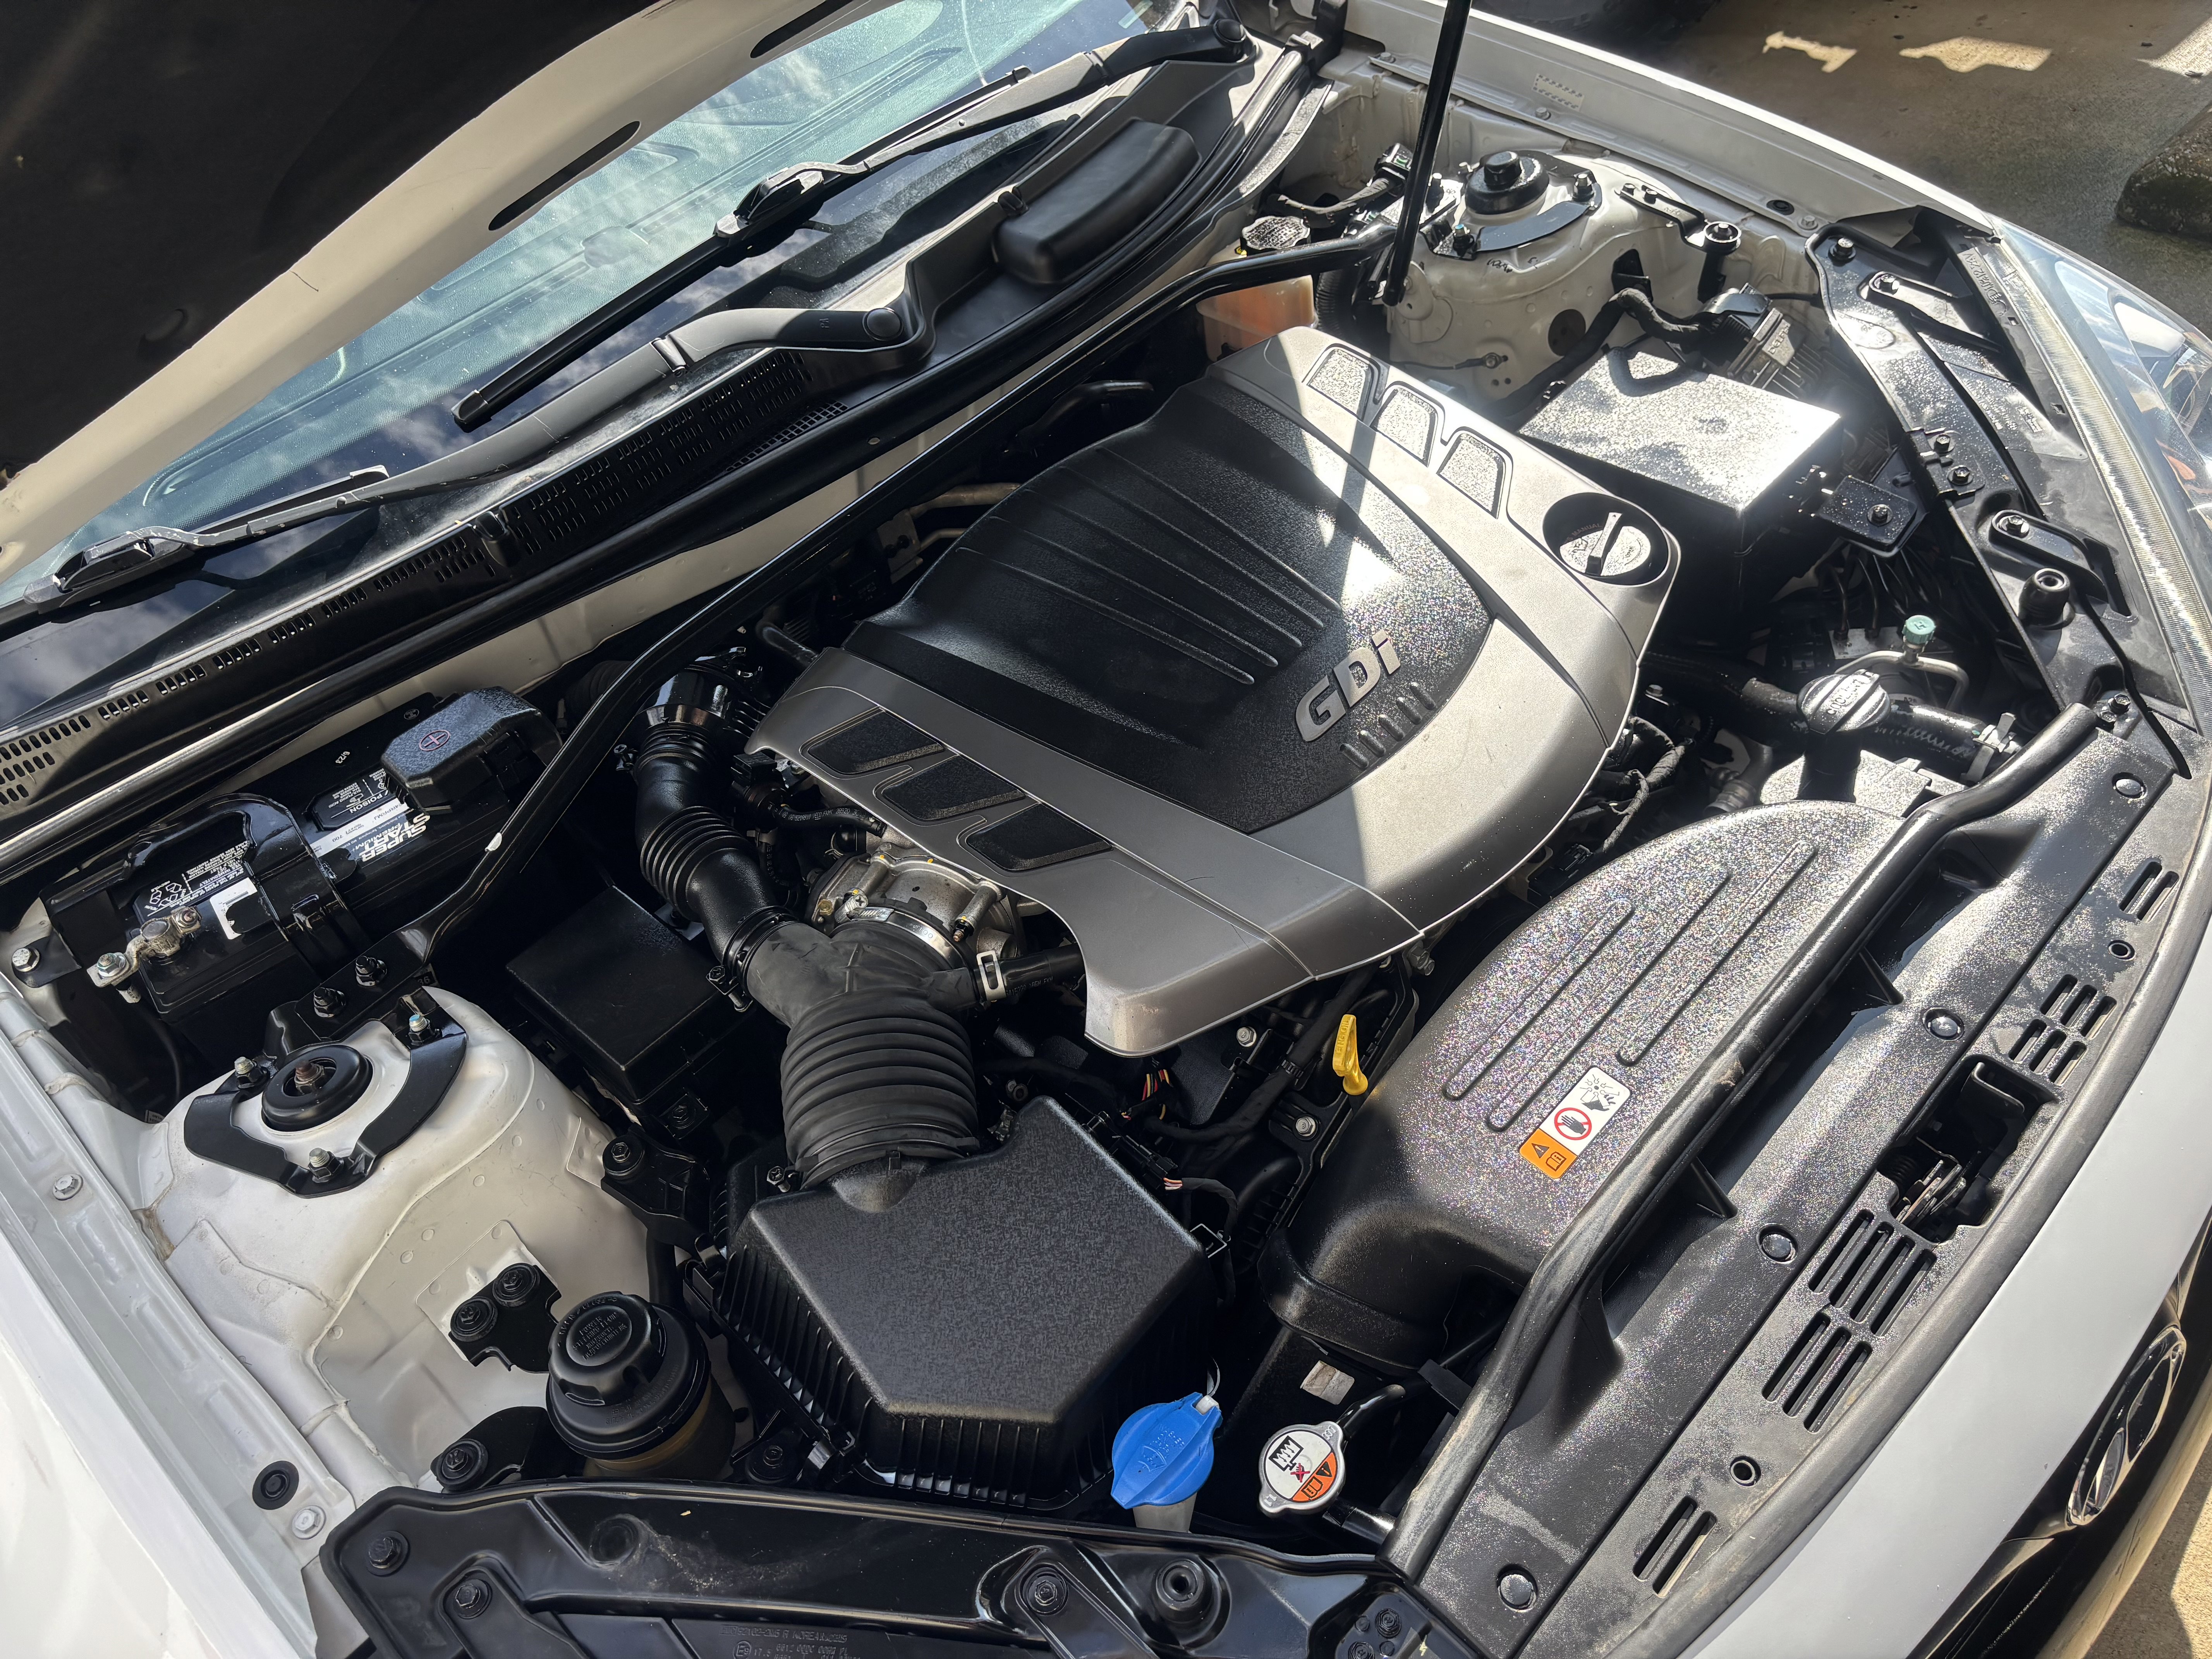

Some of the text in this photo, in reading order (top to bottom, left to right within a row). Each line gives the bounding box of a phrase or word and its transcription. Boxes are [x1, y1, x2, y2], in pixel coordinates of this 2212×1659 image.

[1571, 523, 1602, 536] MANUAL
[1295, 629, 1401, 742] GDi
[335, 751, 350, 764] 6/23
[349, 793, 383, 813] POISON
[354, 822, 400, 850] PREMIUM
[359, 812, 430, 856] START
[361, 825, 427, 862] SUPER
[198, 868, 231, 886] IMMEDIATELY
[209, 858, 236, 874] HELP FAST
[1335, 1020, 1350, 1053] ENG OIL
